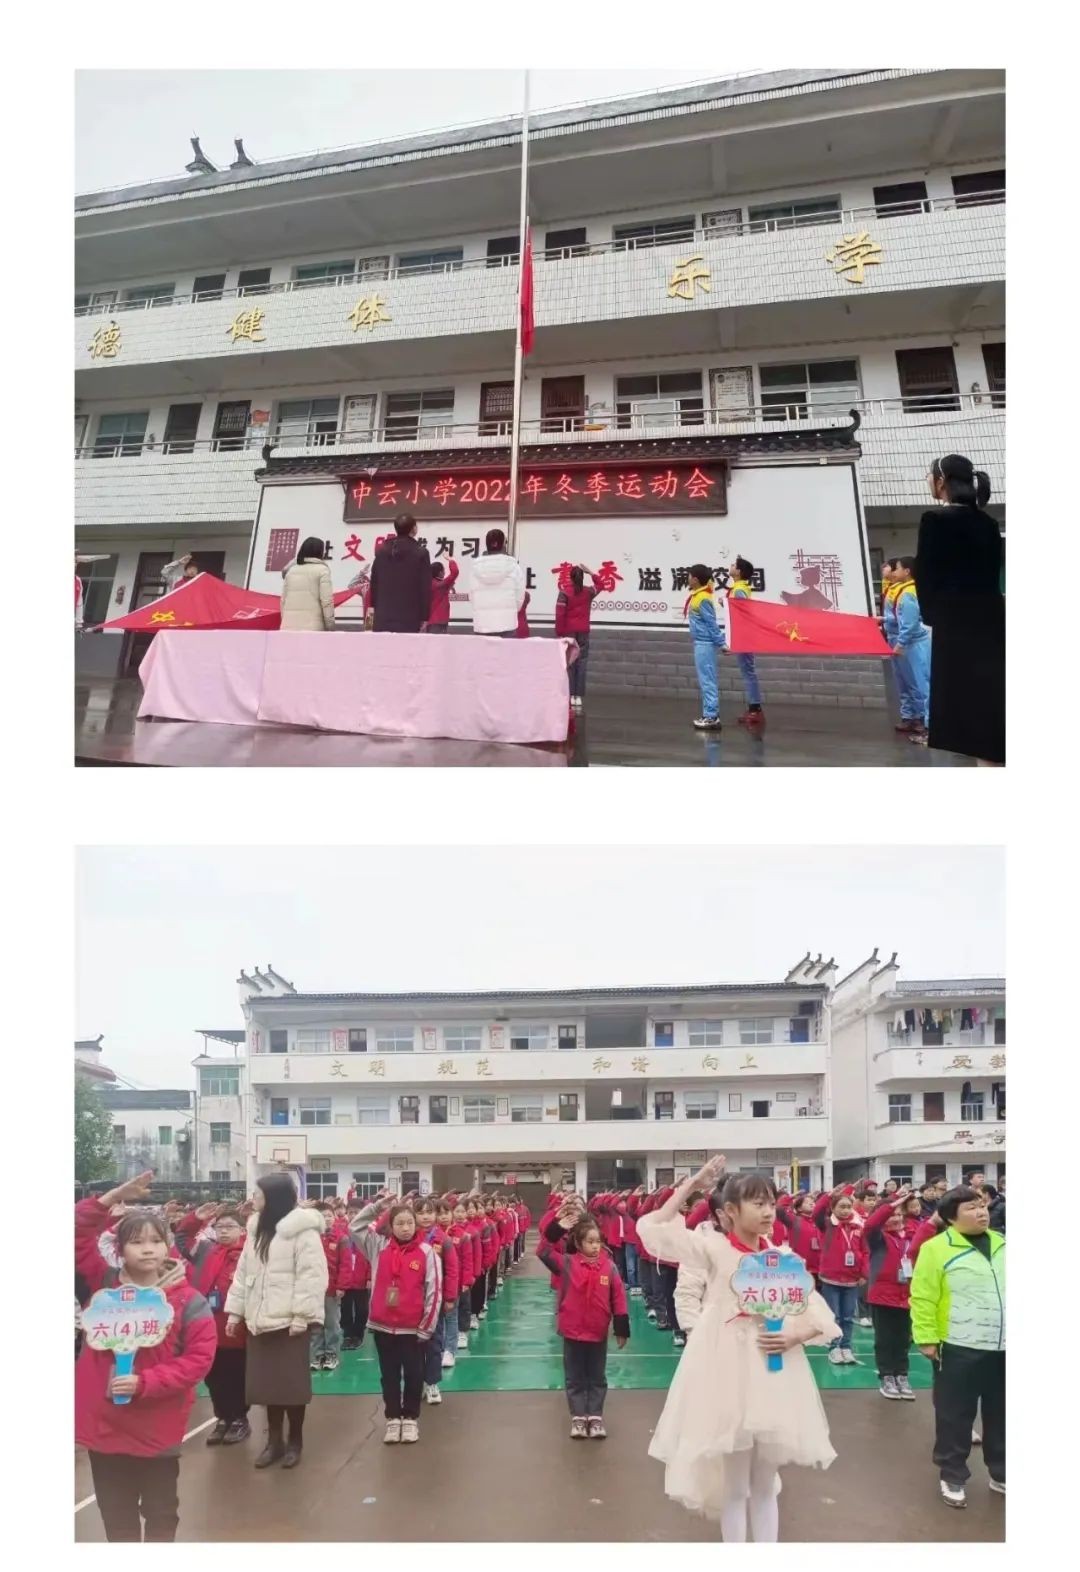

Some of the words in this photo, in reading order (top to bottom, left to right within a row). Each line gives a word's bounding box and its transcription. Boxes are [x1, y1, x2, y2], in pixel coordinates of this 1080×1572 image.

[352, 467, 715, 510] 中云小学2022年冬季运动会
[742, 1286, 804, 1304] 六(3)班
[92, 1319, 160, 1340] 六(4)班
